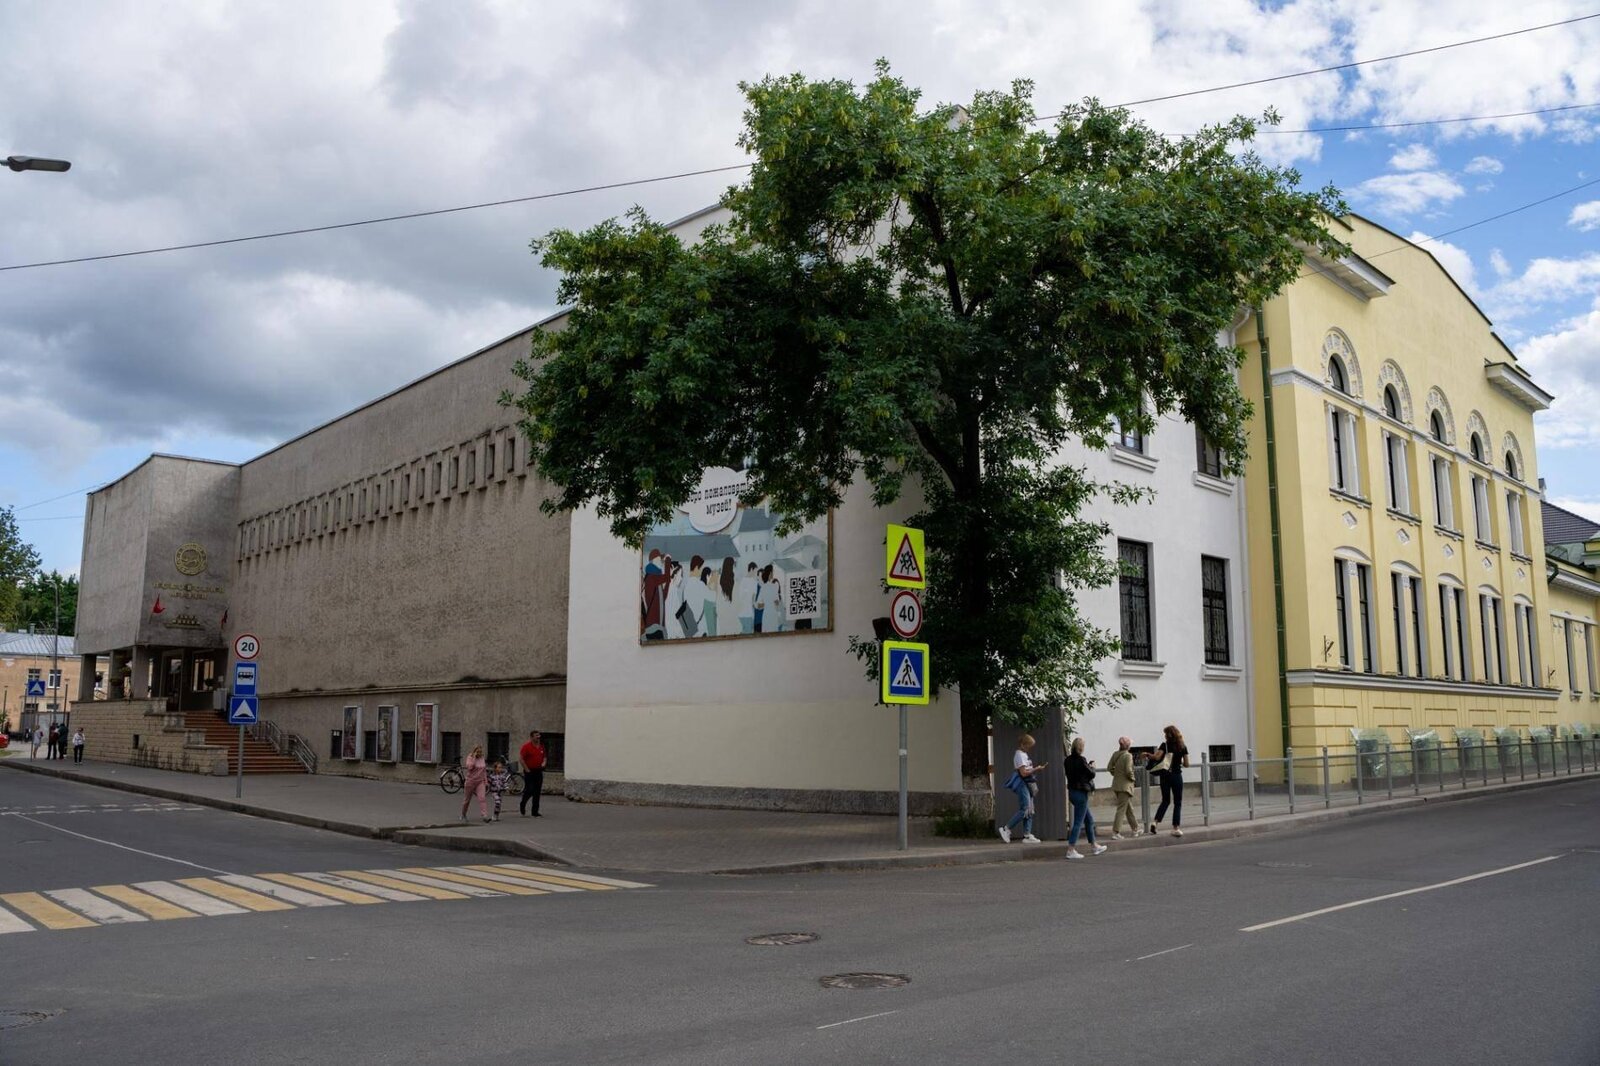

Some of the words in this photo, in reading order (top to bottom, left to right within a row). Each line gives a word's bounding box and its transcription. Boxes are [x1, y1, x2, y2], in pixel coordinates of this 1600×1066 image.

[706, 498, 732, 516] музей!
[899, 604, 915, 622] 40
[241, 641, 255, 652] 20
